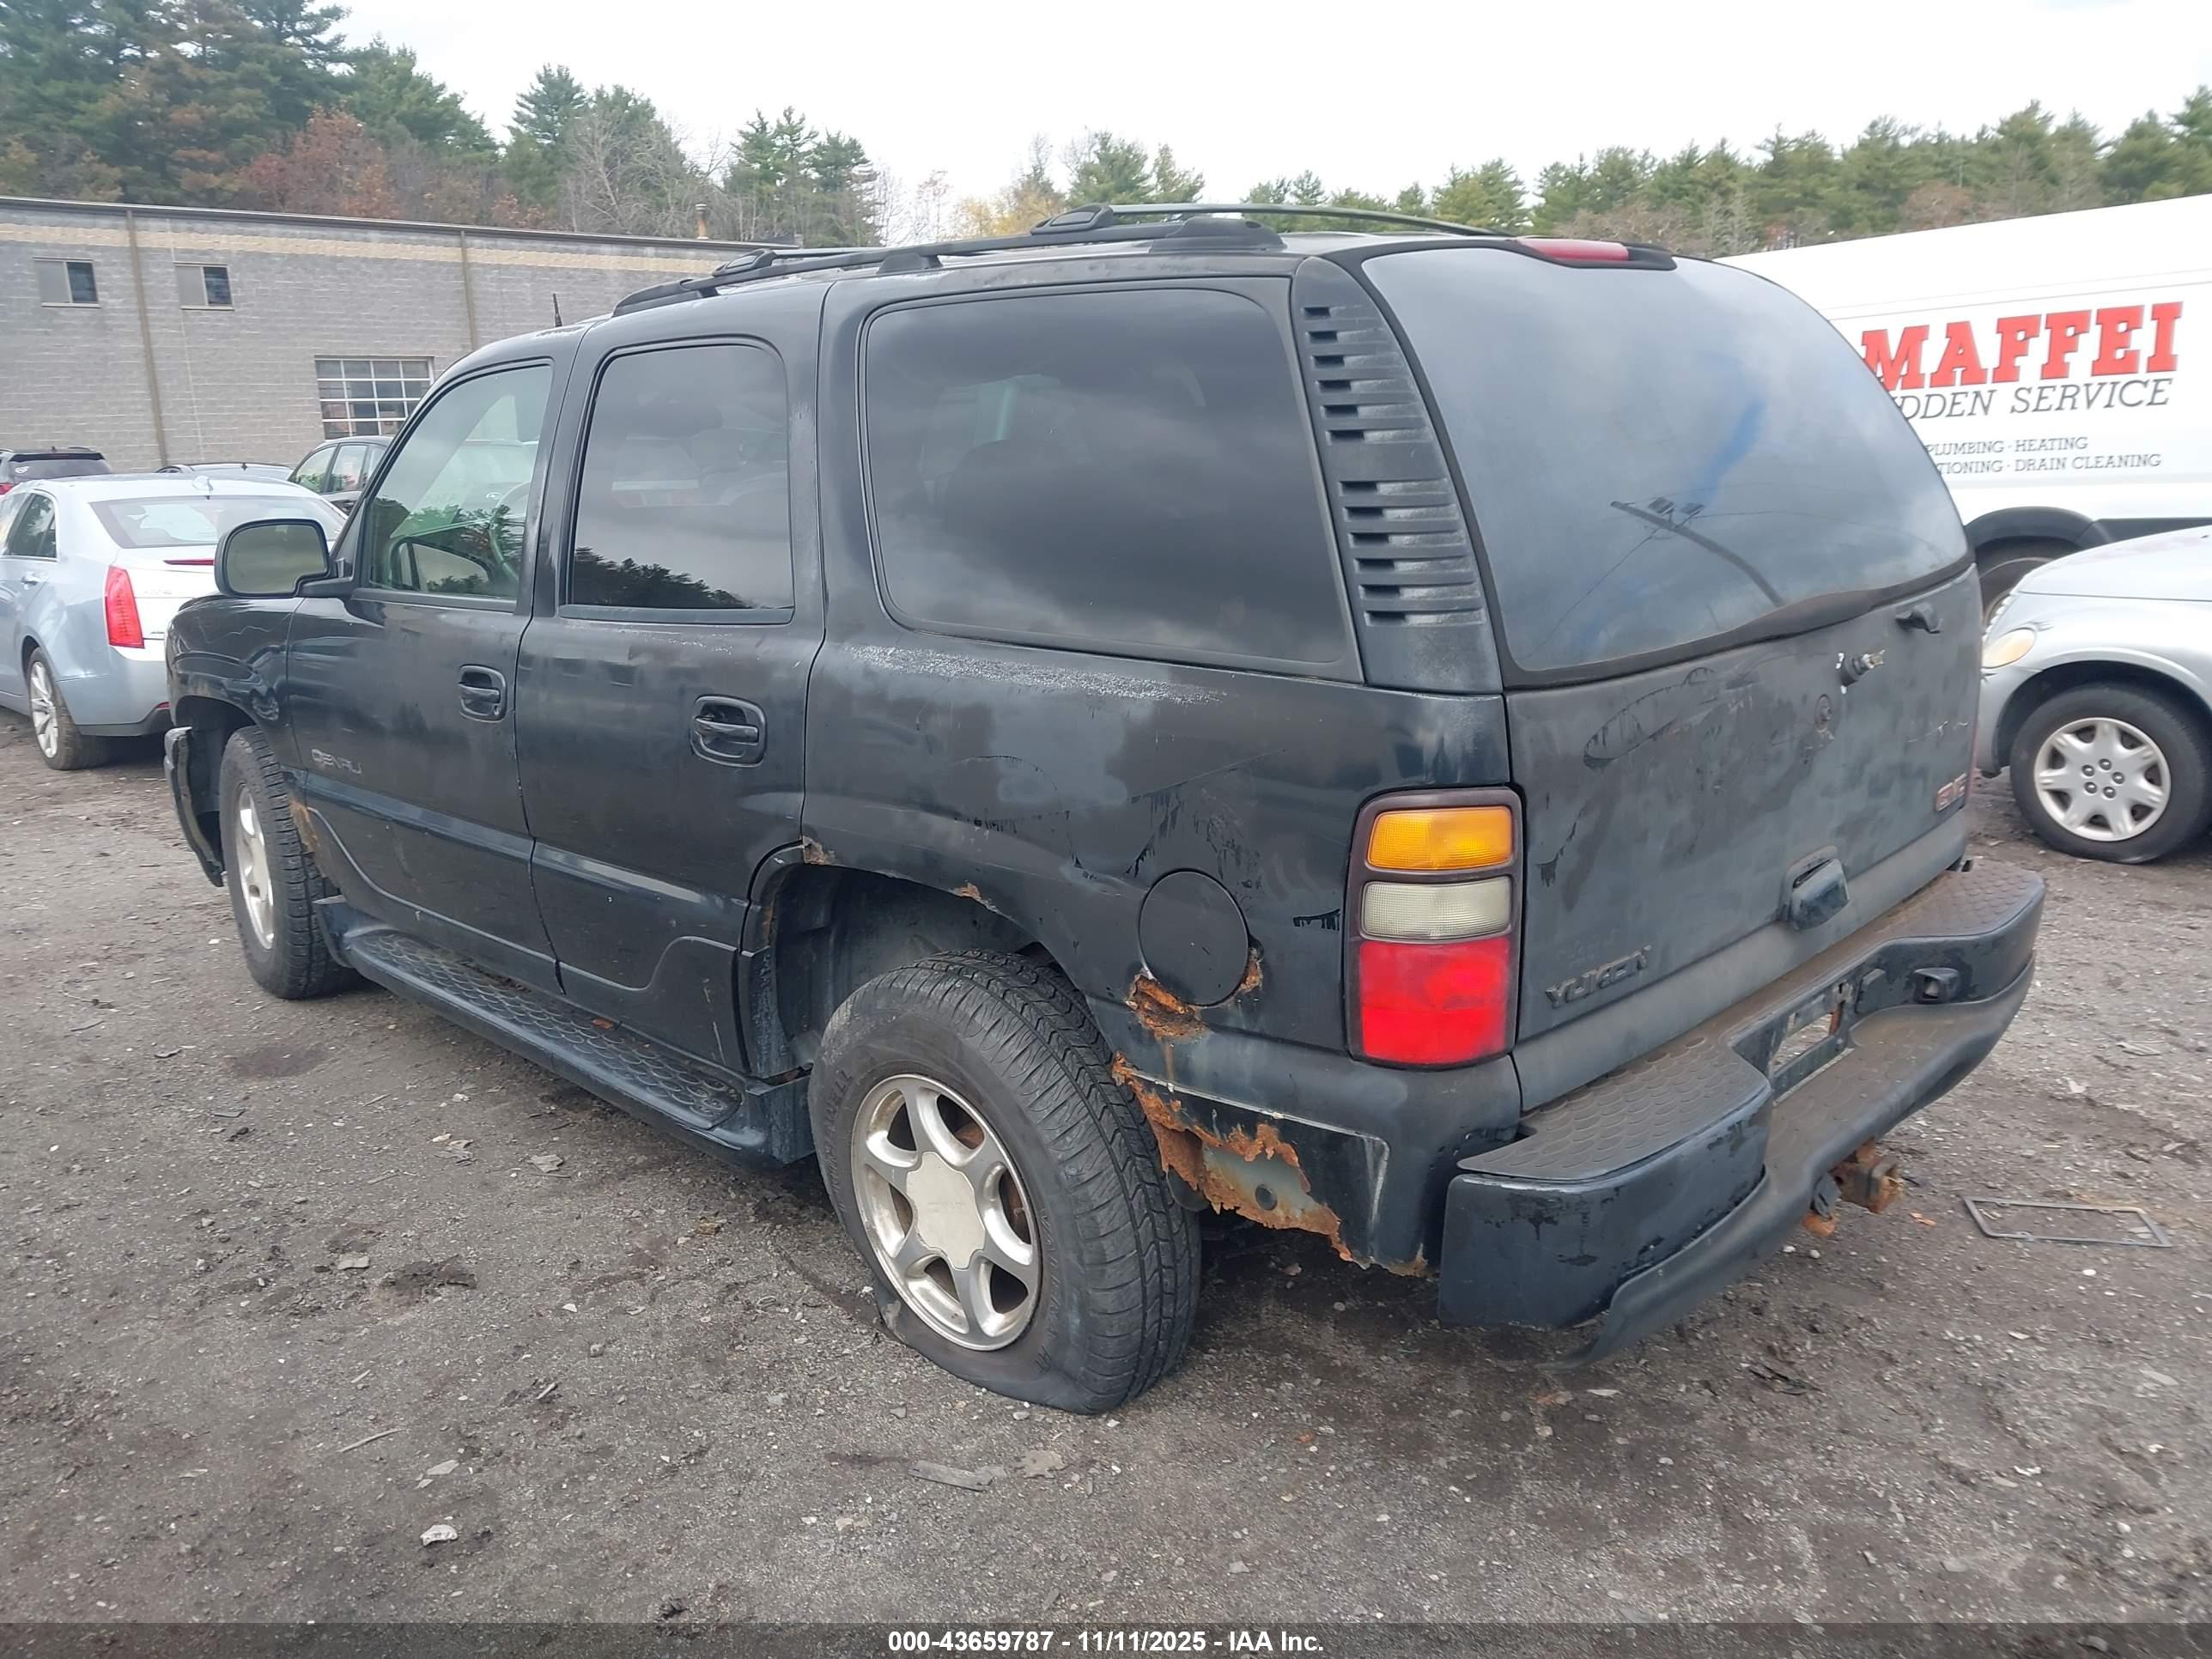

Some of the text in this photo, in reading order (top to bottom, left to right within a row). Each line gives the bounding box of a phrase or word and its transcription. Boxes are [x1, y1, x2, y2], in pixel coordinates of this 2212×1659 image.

[1861, 301, 2183, 391] MAFFEI
[1892, 378, 2173, 420] DDEN SERVICE
[1923, 436, 2088, 457] PLUMBING HEATING
[2014, 457, 2067, 472] DRAIN
[2071, 453, 2162, 470] CLEANING
